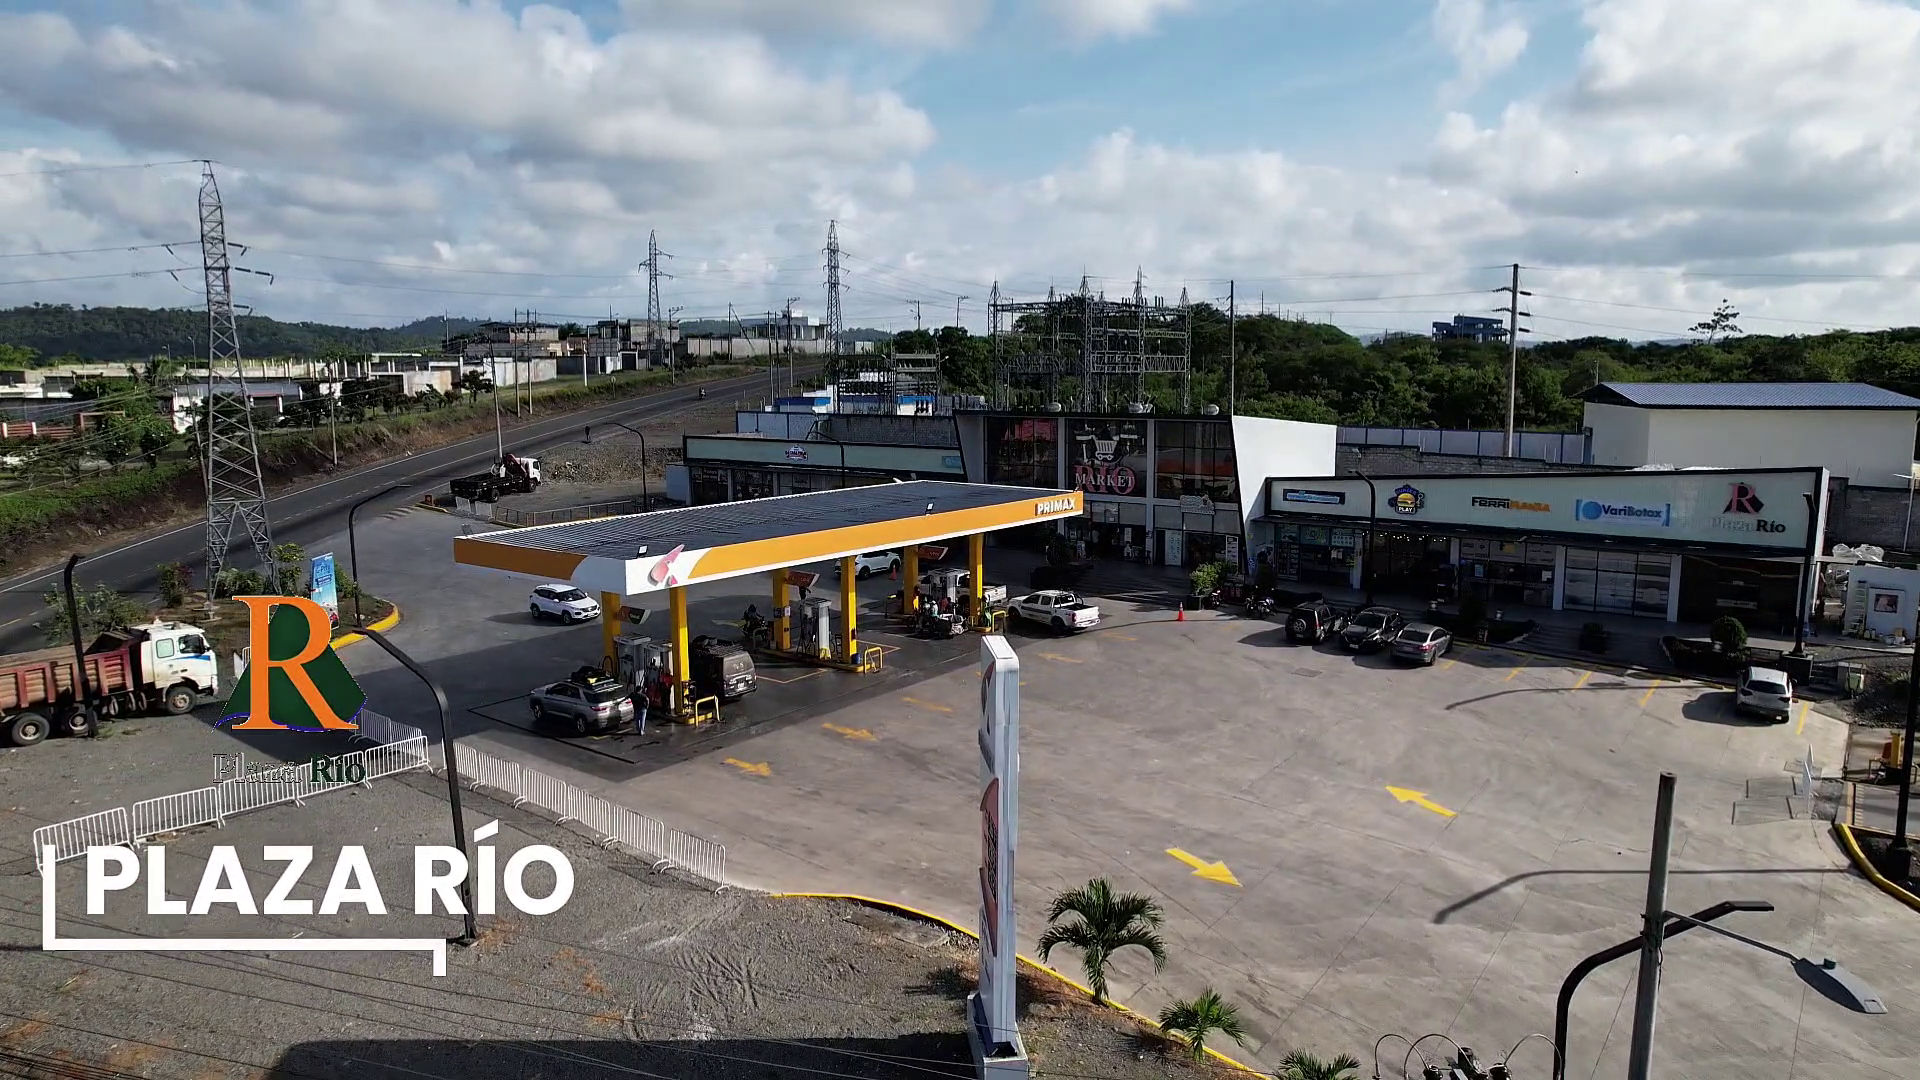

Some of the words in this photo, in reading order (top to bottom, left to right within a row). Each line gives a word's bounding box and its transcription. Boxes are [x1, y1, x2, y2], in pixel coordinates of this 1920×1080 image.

[1075, 473, 1135, 487] MARKET
[1036, 498, 1076, 516] PRIMAX
[1601, 504, 1663, 519] VariBotox
[1756, 519, 1786, 533] Río
